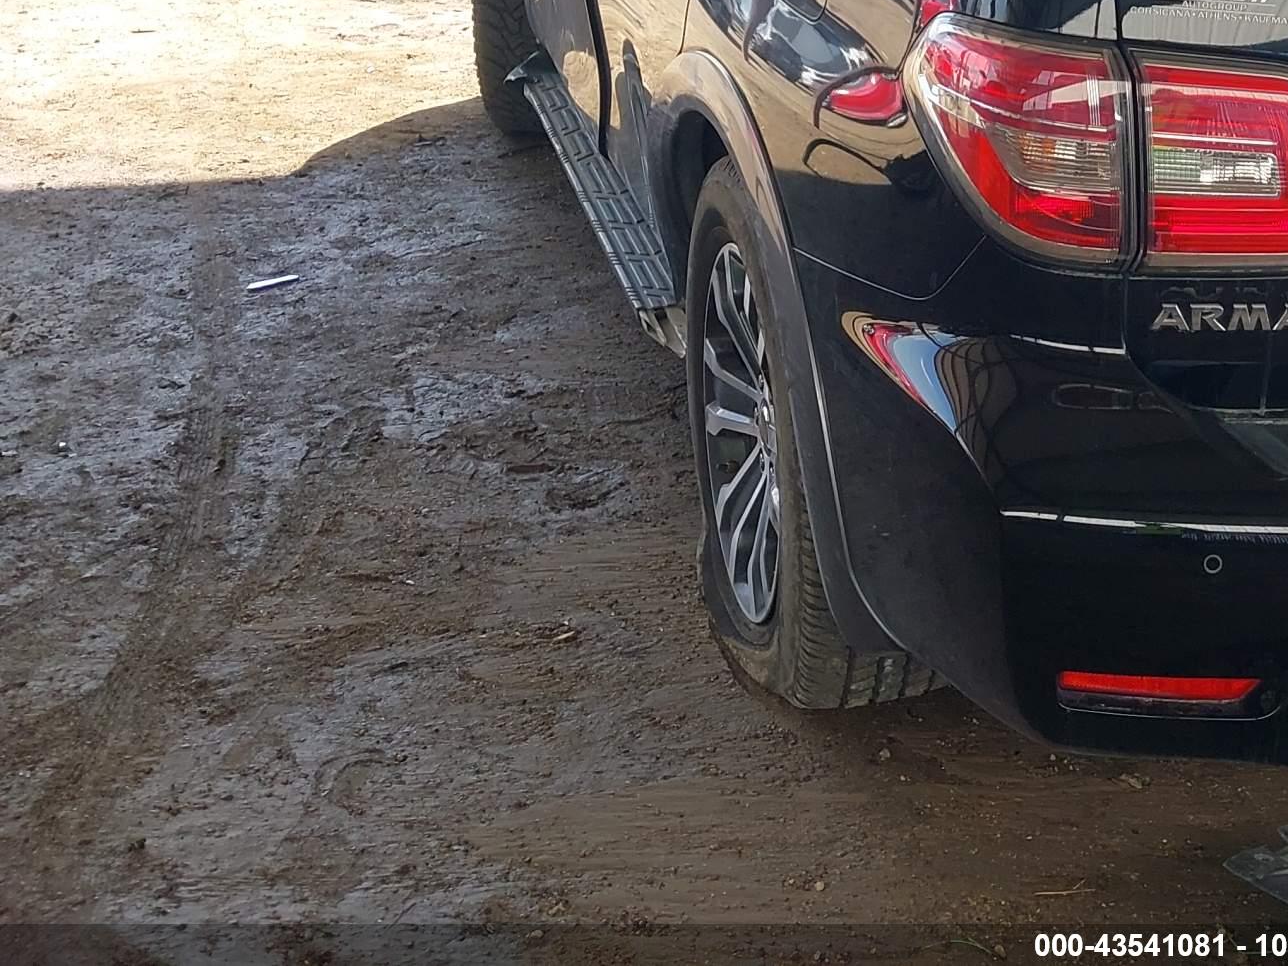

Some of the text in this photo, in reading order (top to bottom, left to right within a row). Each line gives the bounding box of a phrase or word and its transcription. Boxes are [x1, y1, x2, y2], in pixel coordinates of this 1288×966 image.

[1181, 0, 1249, 12] AUTOGROUP
[1130, 5, 1192, 19] CORSICANA
[1198, 10, 1238, 22] ATHENS
